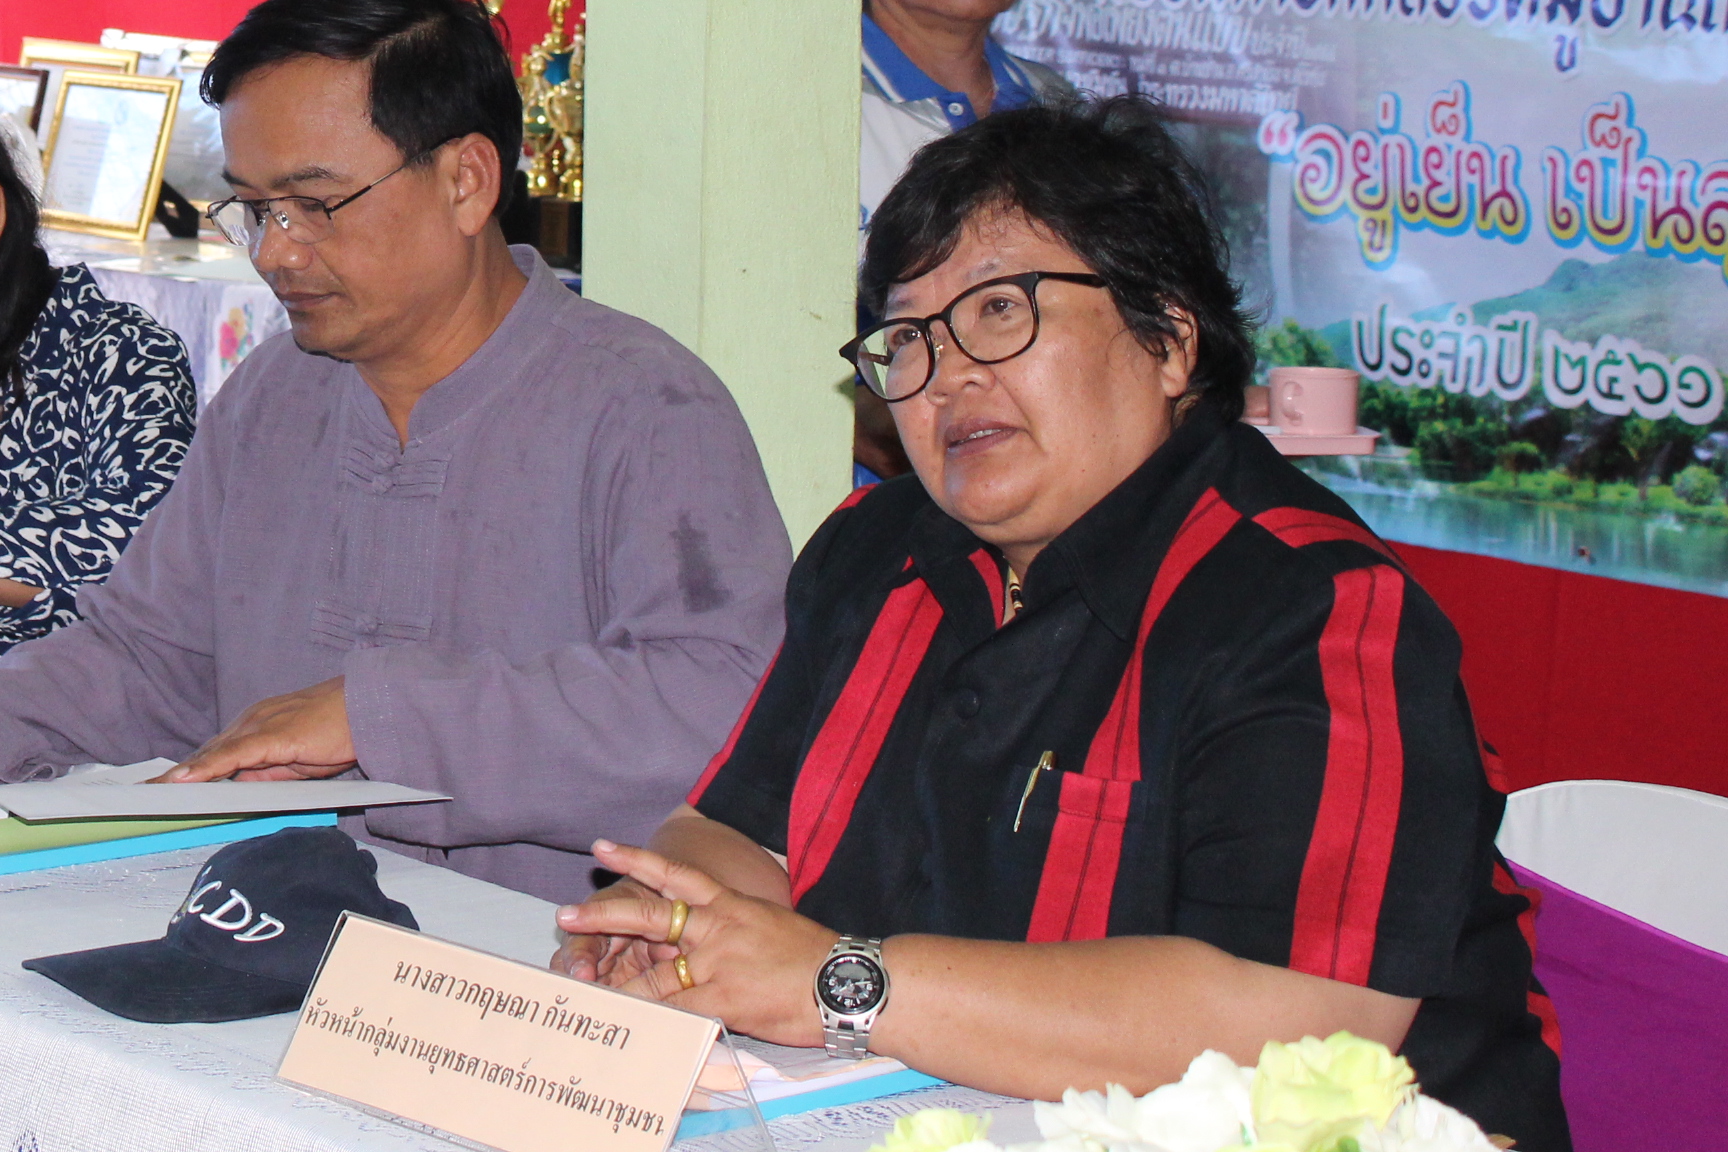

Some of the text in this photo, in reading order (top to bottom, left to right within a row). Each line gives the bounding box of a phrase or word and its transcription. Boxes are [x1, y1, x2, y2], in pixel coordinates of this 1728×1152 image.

[1353, 304, 1724, 427] ประจำปี ๒๕๖๑
[186, 879, 286, 943] CDD
[392, 956, 632, 1052] นางสาวกฤษณา กันทะสา
